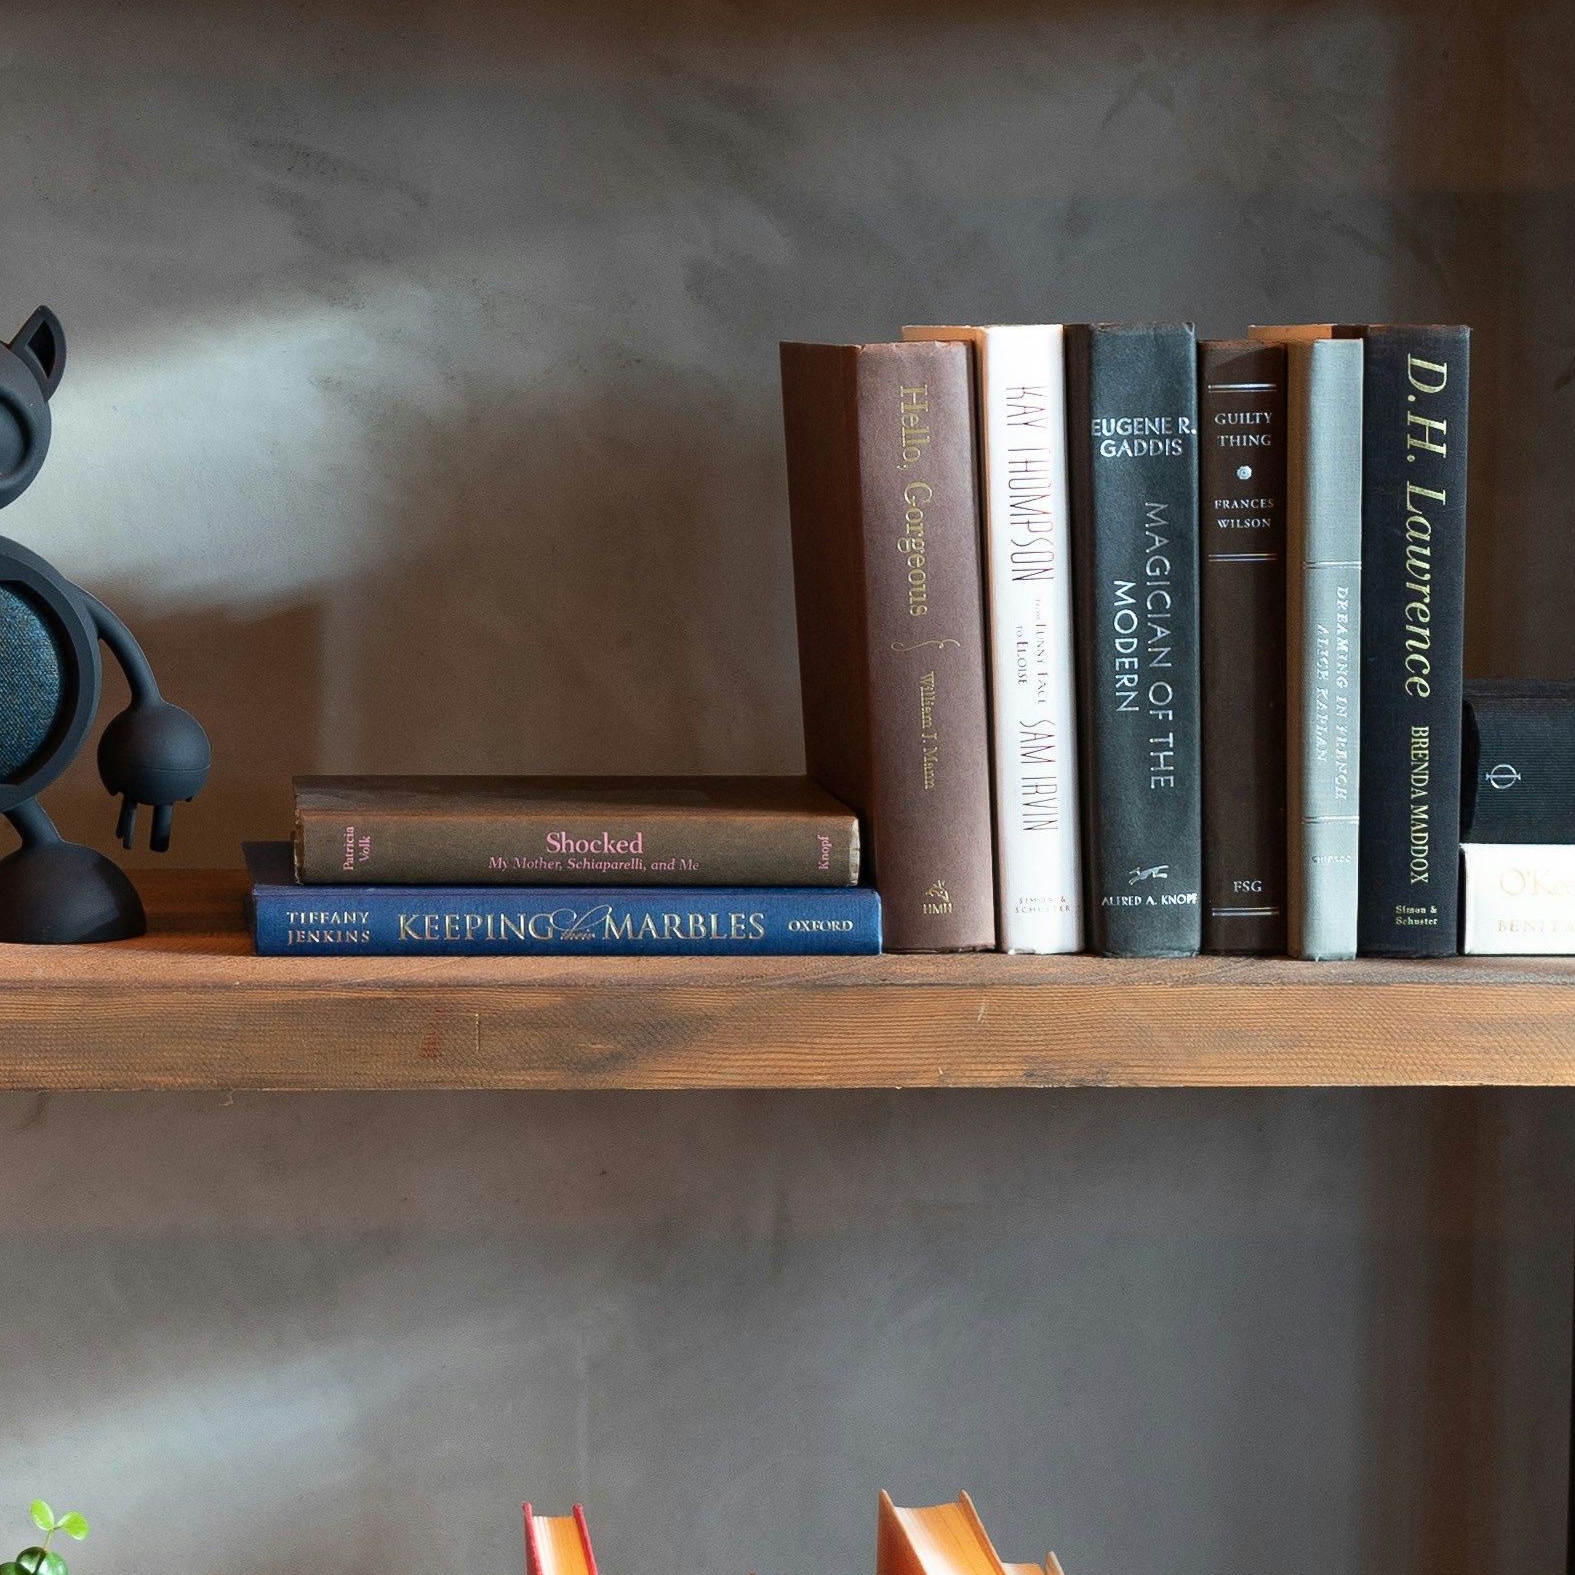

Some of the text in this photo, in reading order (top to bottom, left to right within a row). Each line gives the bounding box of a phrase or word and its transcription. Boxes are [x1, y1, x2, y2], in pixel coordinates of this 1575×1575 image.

[1091, 416, 1198, 438] EUGENE R.
[1214, 412, 1273, 425] GUILTY
[1099, 438, 1183, 458] GADDIS
[1217, 434, 1272, 447] THING
[1006, 386, 1055, 582] KAY THOMPSON
[897, 385, 933, 617] Hello, Gorgeous
[1214, 498, 1274, 510] FRANCES
[1217, 518, 1272, 529] WILSON
[1405, 479, 1446, 699] Lawrence
[1113, 579, 1140, 713] MODERN
[1144, 501, 1174, 789] MAGICIAN OF THE
[1315, 623, 1330, 763] ALICE KAPLAN
[1334, 586, 1349, 801] DREAMING IN FRENCH
[1019, 719, 1059, 831] SAM IRVIN
[1410, 725, 1430, 886] BRENDA MADDOX
[343, 825, 355, 871] Patricia
[359, 835, 372, 863] Volk
[545, 831, 645, 854] Shocked
[488, 857, 700, 873] My Mother, Schiaparelli, and Me
[1233, 880, 1263, 893] FSG
[286, 911, 370, 925] TIFFANY
[398, 912, 554, 941] KEEPING
[604, 912, 765, 941] MARBLES
[788, 919, 854, 933] OXFORD
[286, 930, 371, 946] JENKINS
